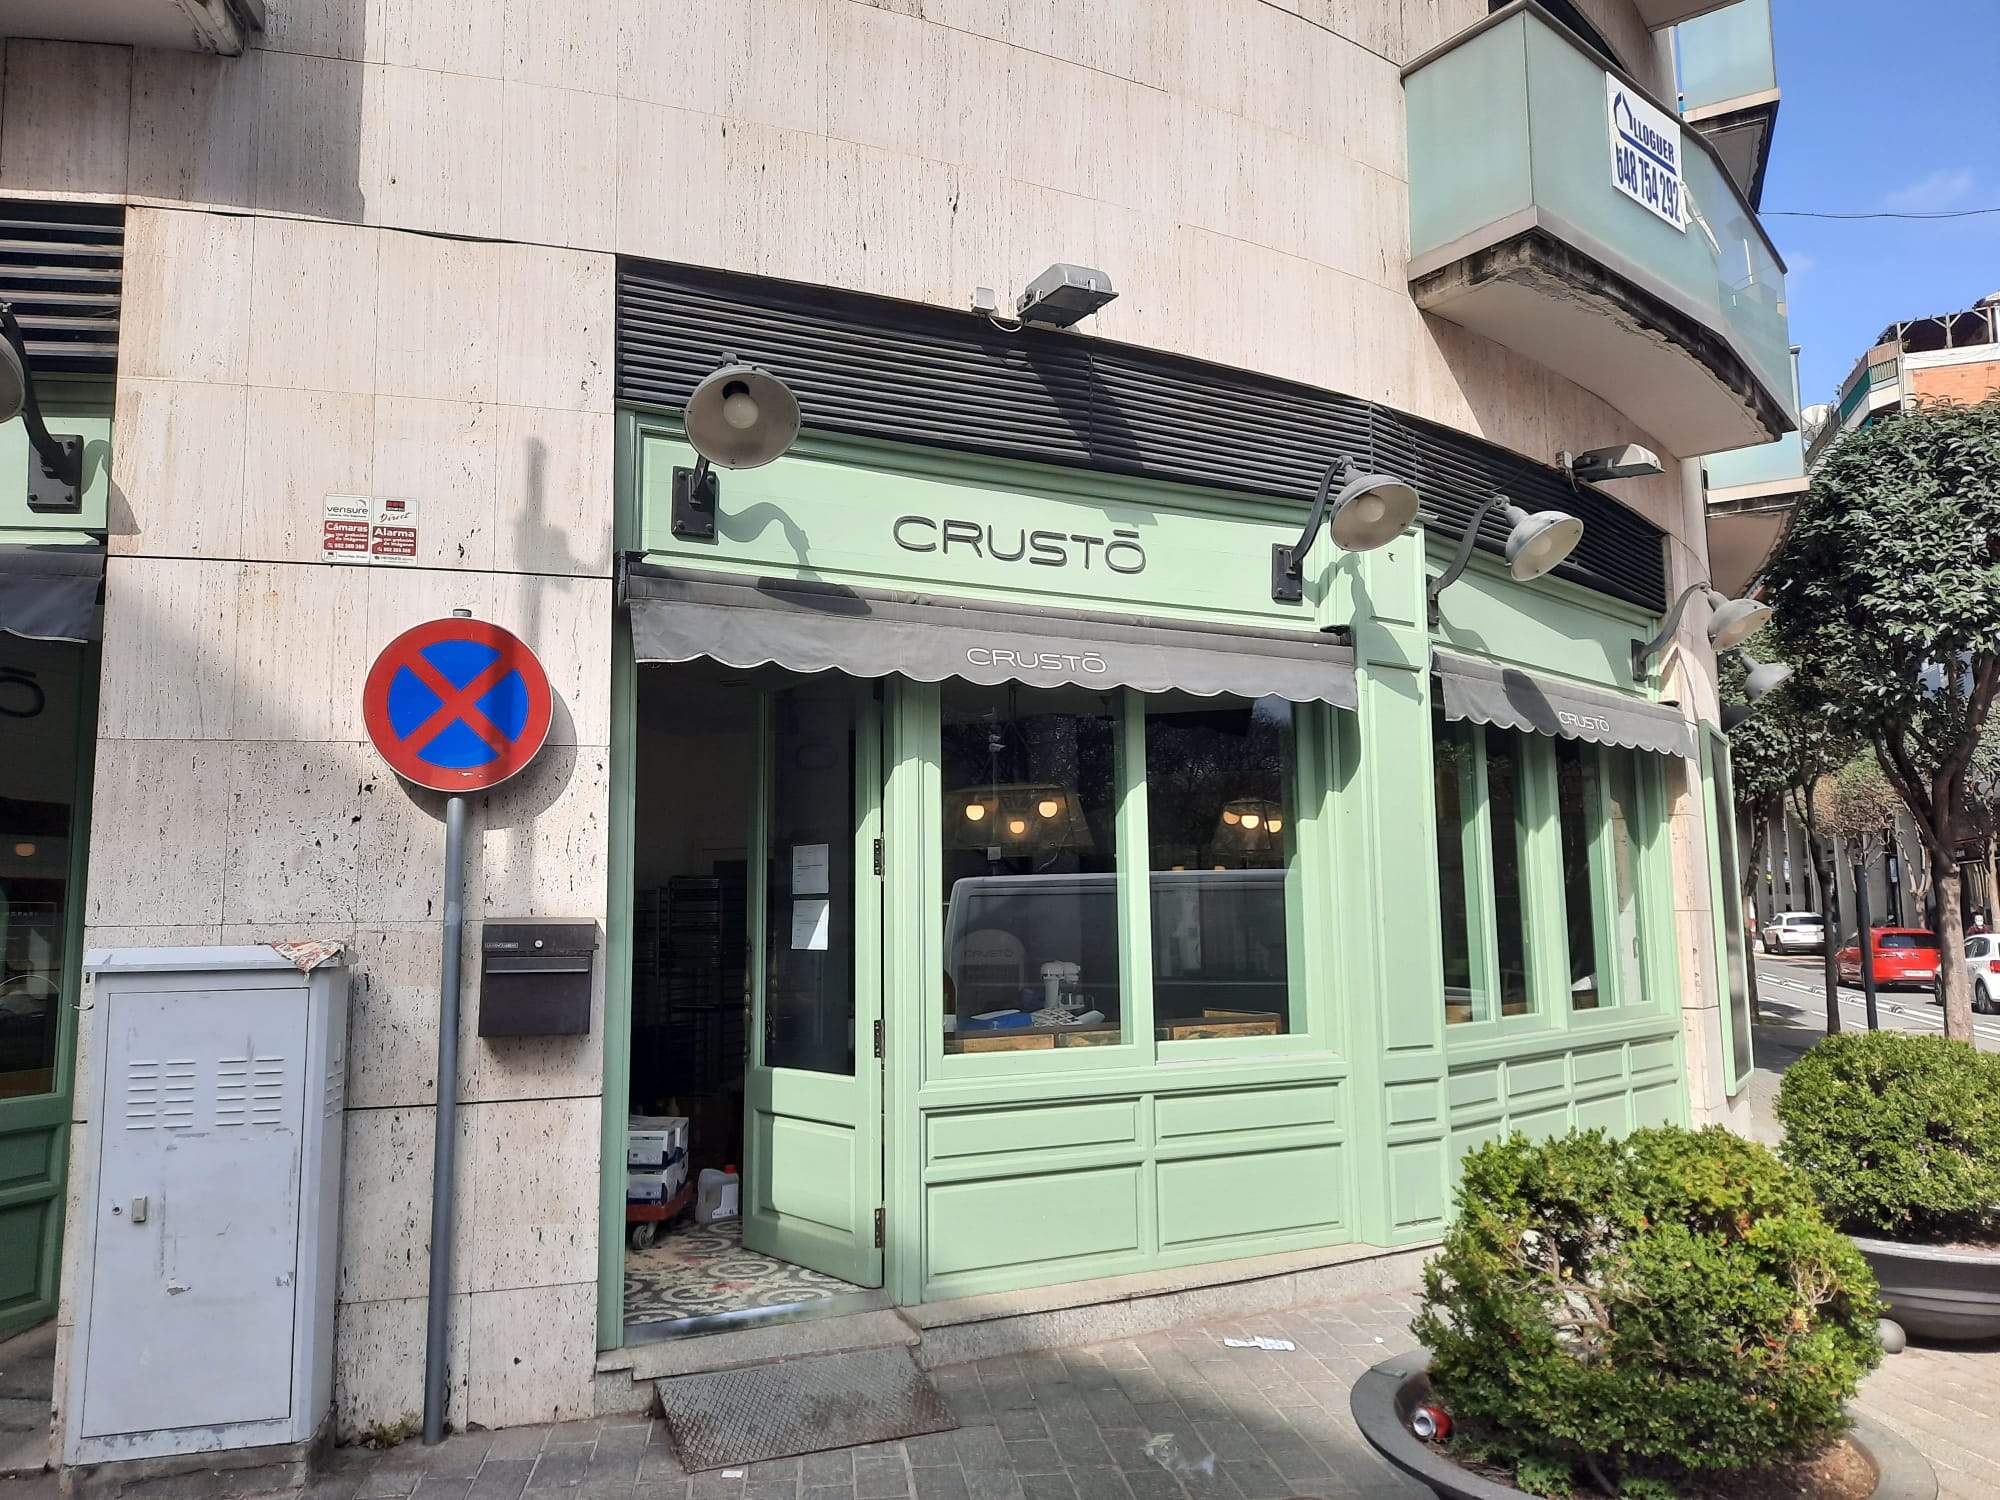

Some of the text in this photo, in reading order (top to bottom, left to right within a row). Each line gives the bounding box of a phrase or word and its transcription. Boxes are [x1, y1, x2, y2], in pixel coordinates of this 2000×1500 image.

[1632, 117, 1675, 165] LLOGUER
[1615, 141, 1681, 224] 648 754 292
[327, 506, 368, 514] verisure
[326, 522, 368, 533] Cámaras
[374, 527, 415, 538] Alarma
[893, 514, 1147, 575] CRUSTŌ
[965, 646, 1108, 674] CRUSTŌ
[1558, 711, 1610, 732] CRUSTŌ
